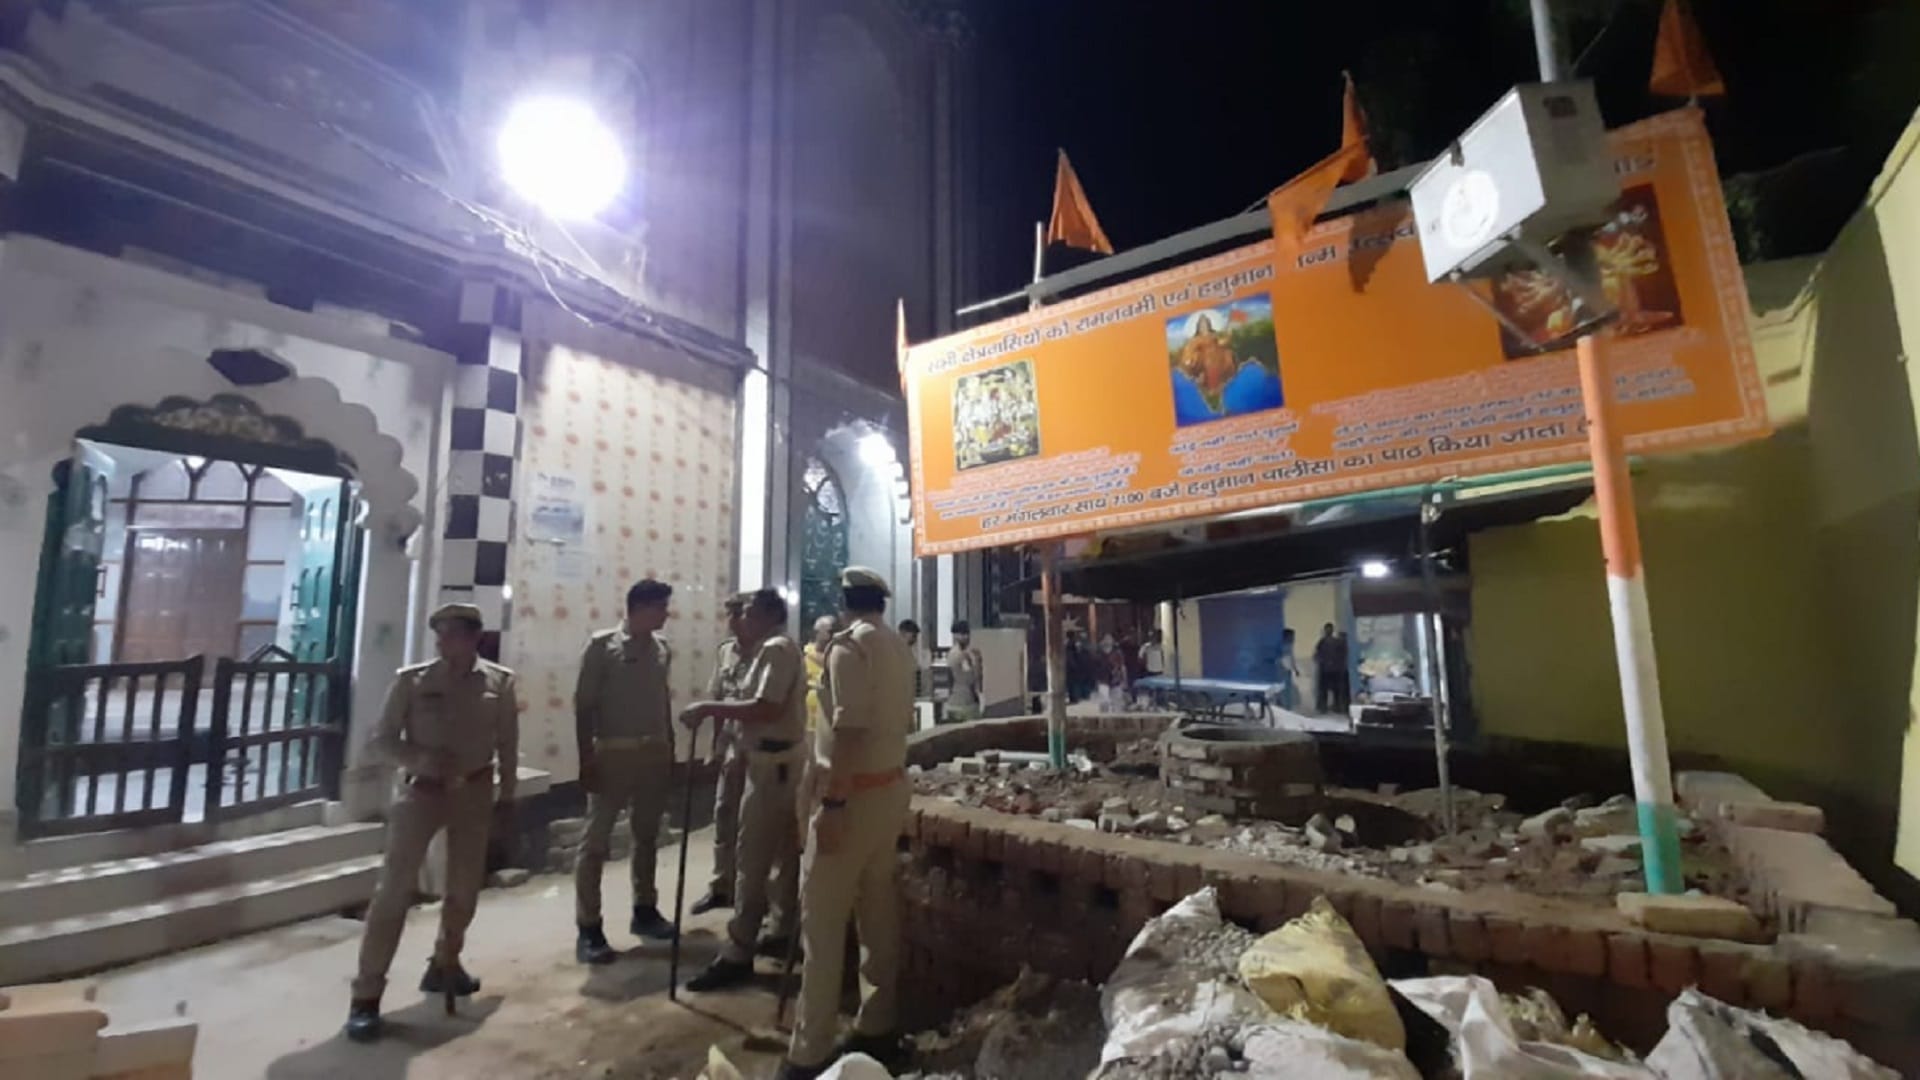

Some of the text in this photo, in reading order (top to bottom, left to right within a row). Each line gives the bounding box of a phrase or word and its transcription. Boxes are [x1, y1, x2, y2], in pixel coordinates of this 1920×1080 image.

[1046, 320, 1070, 339] को
[1076, 294, 1156, 331] रामनवमी
[1197, 264, 1274, 298] हनुमान
[981, 514, 1000, 530] हर
[1005, 502, 1070, 525] मंगलवार
[1074, 492, 1110, 513] सायं
[1113, 491, 1145, 506] 7:00
[1149, 481, 1180, 501] बजे
[1187, 471, 1255, 498] हनुमान
[1262, 459, 1336, 482] चालीसा
[1343, 454, 1375, 469] का
[1381, 444, 1422, 464] पाठ
[1427, 434, 1492, 457] किया
[1501, 420, 1566, 444] जाता
